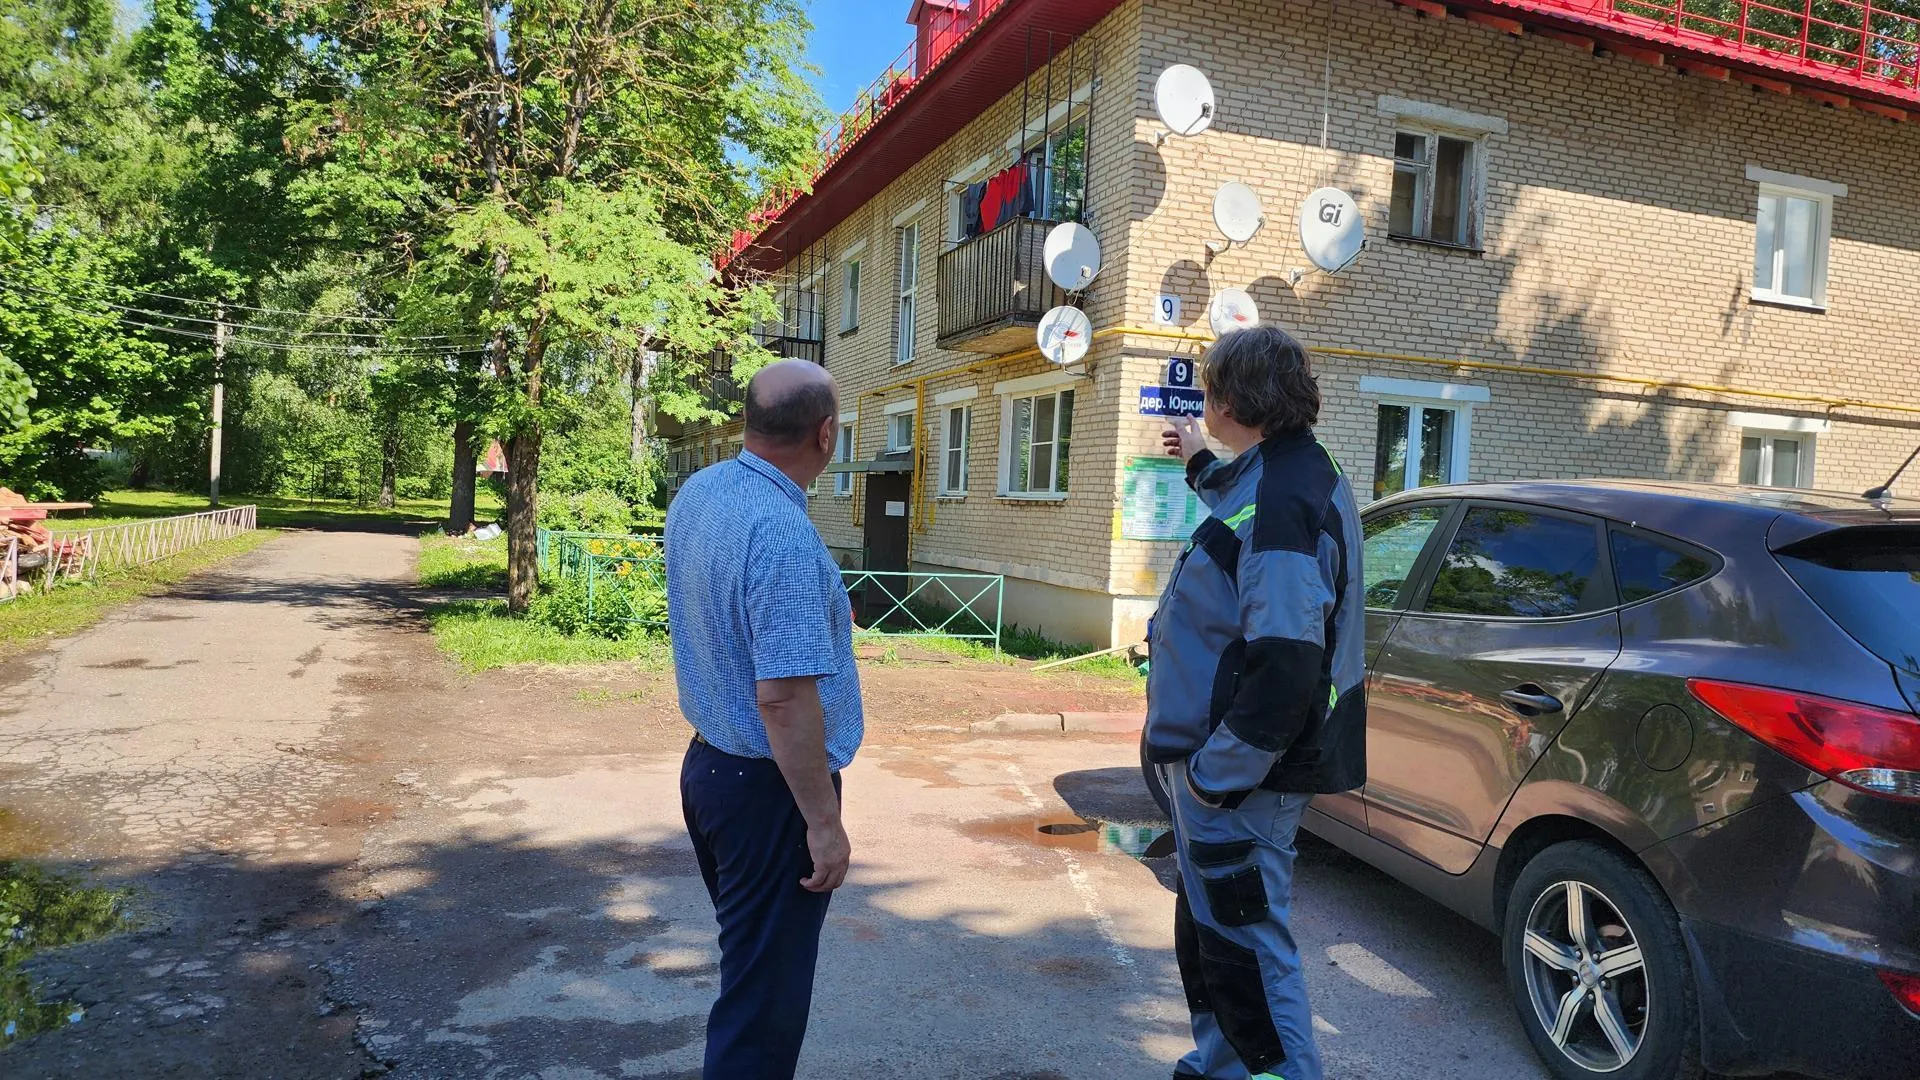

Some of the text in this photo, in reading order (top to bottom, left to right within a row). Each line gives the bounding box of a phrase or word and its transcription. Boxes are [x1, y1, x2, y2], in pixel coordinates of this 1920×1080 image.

[1319, 203, 1343, 224] Gi
[1162, 299, 1173, 321] 9
[1175, 362, 1188, 382] 9
[1140, 395, 1203, 413] дер. Юрки
